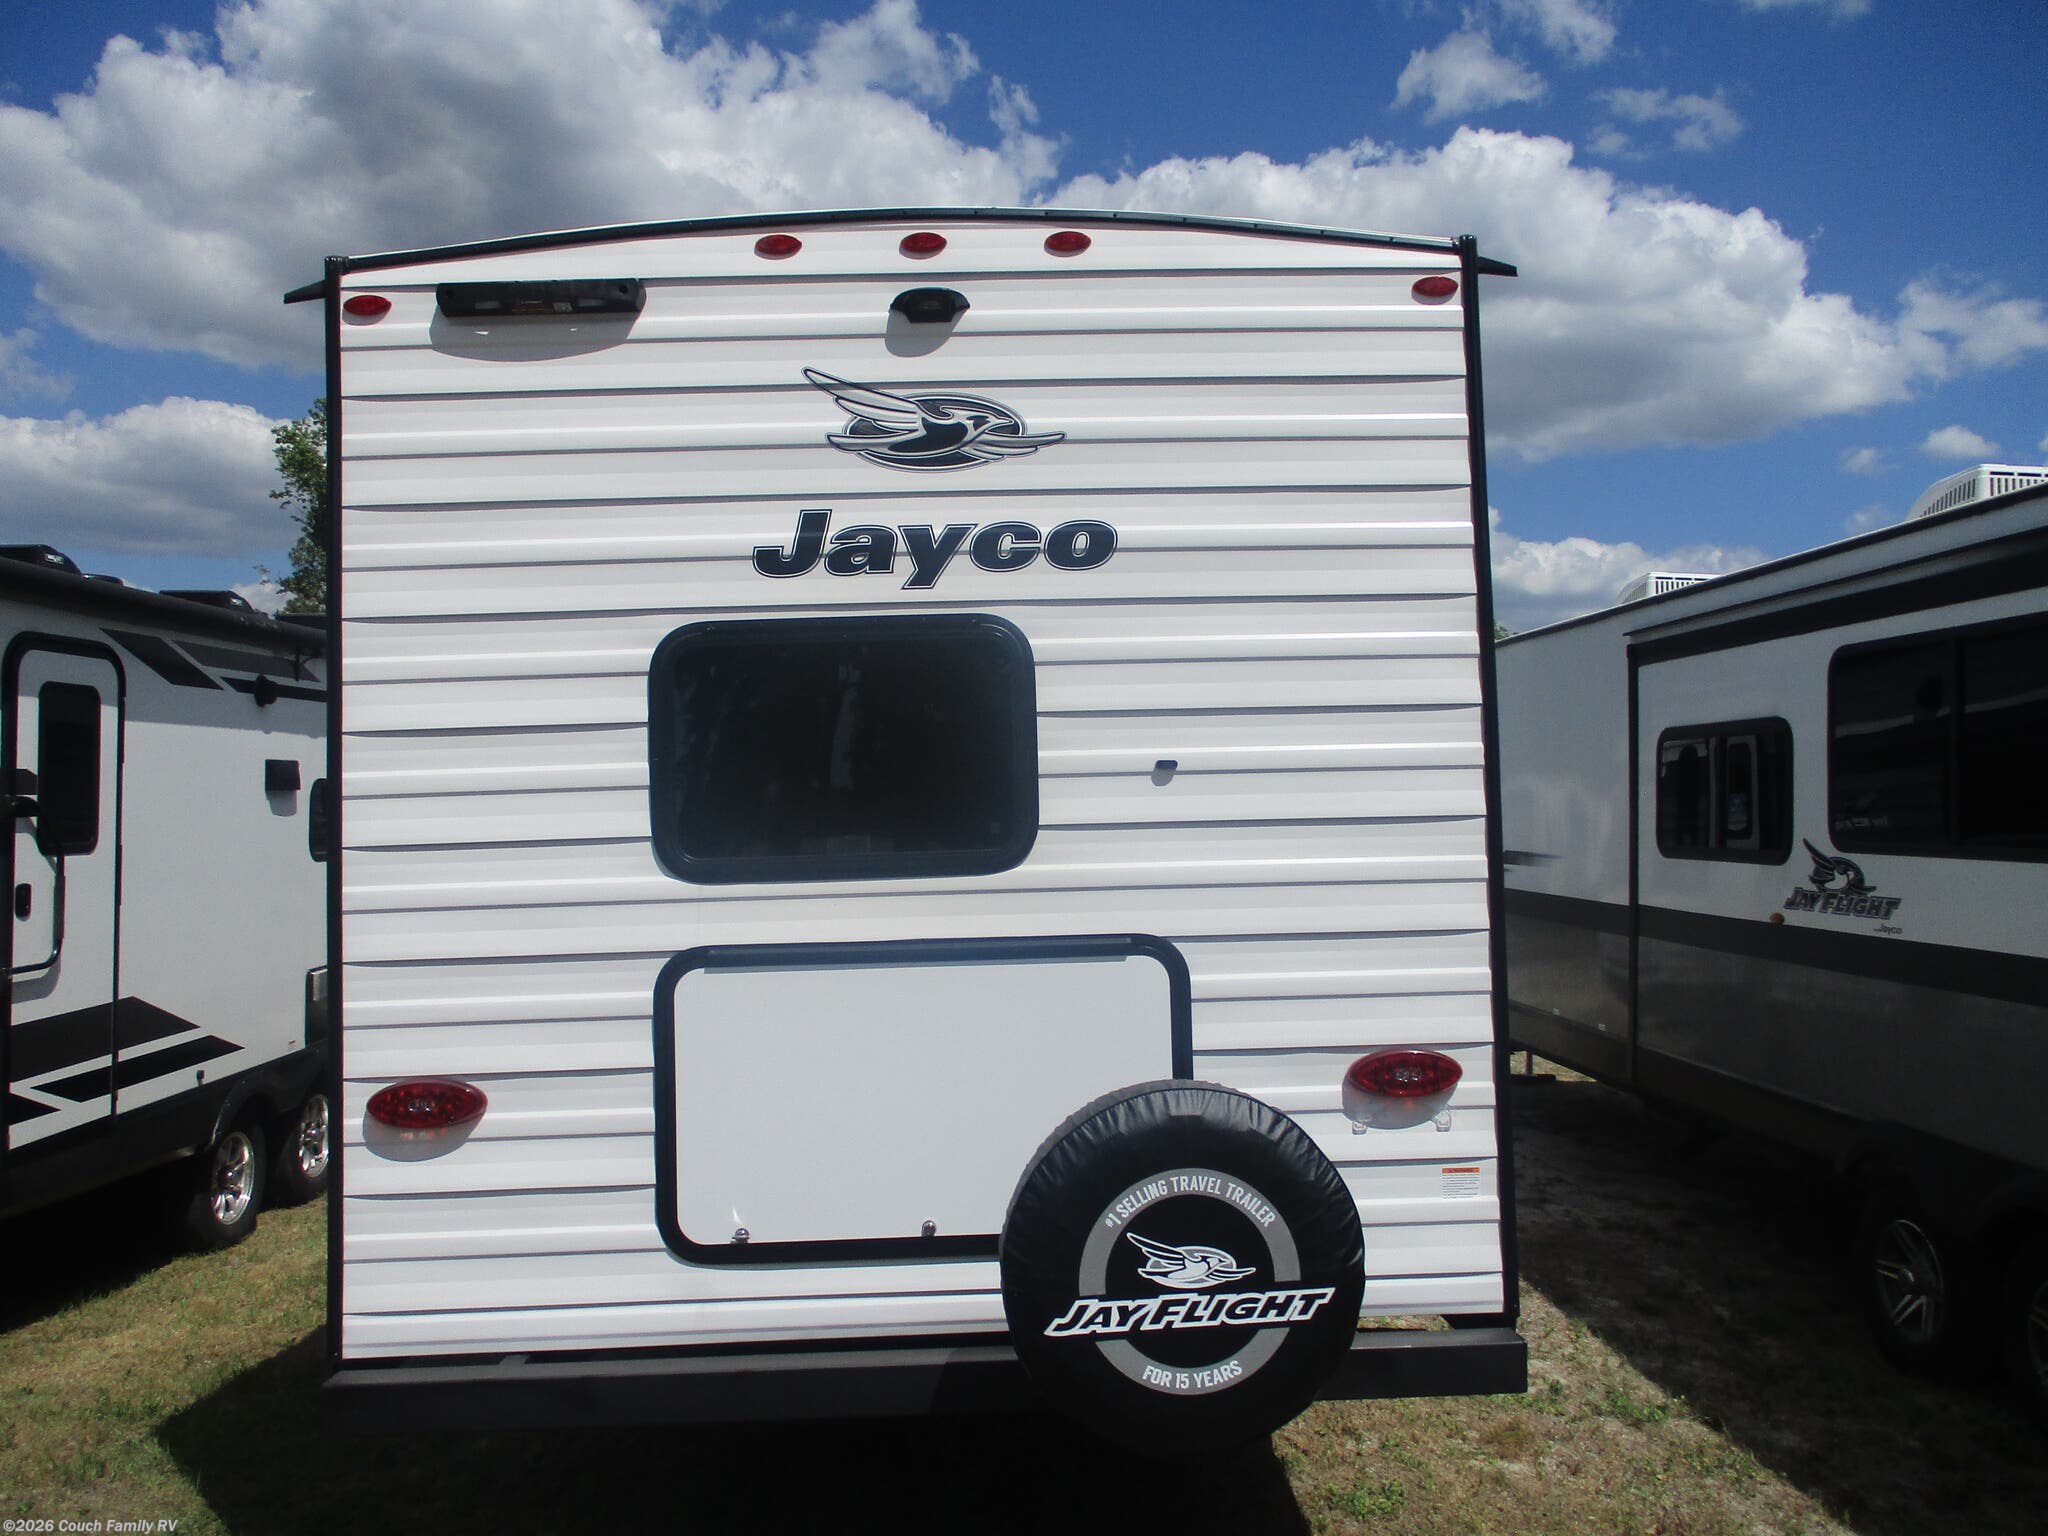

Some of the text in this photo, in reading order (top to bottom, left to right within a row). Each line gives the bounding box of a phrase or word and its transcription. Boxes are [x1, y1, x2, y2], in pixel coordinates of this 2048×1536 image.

[752, 509, 1118, 590] Jayco
[1105, 1175, 1276, 1228] #1 SELLING TRAVEL TRAILER
[1142, 1360, 1242, 1389] FOR 15 YEARS
